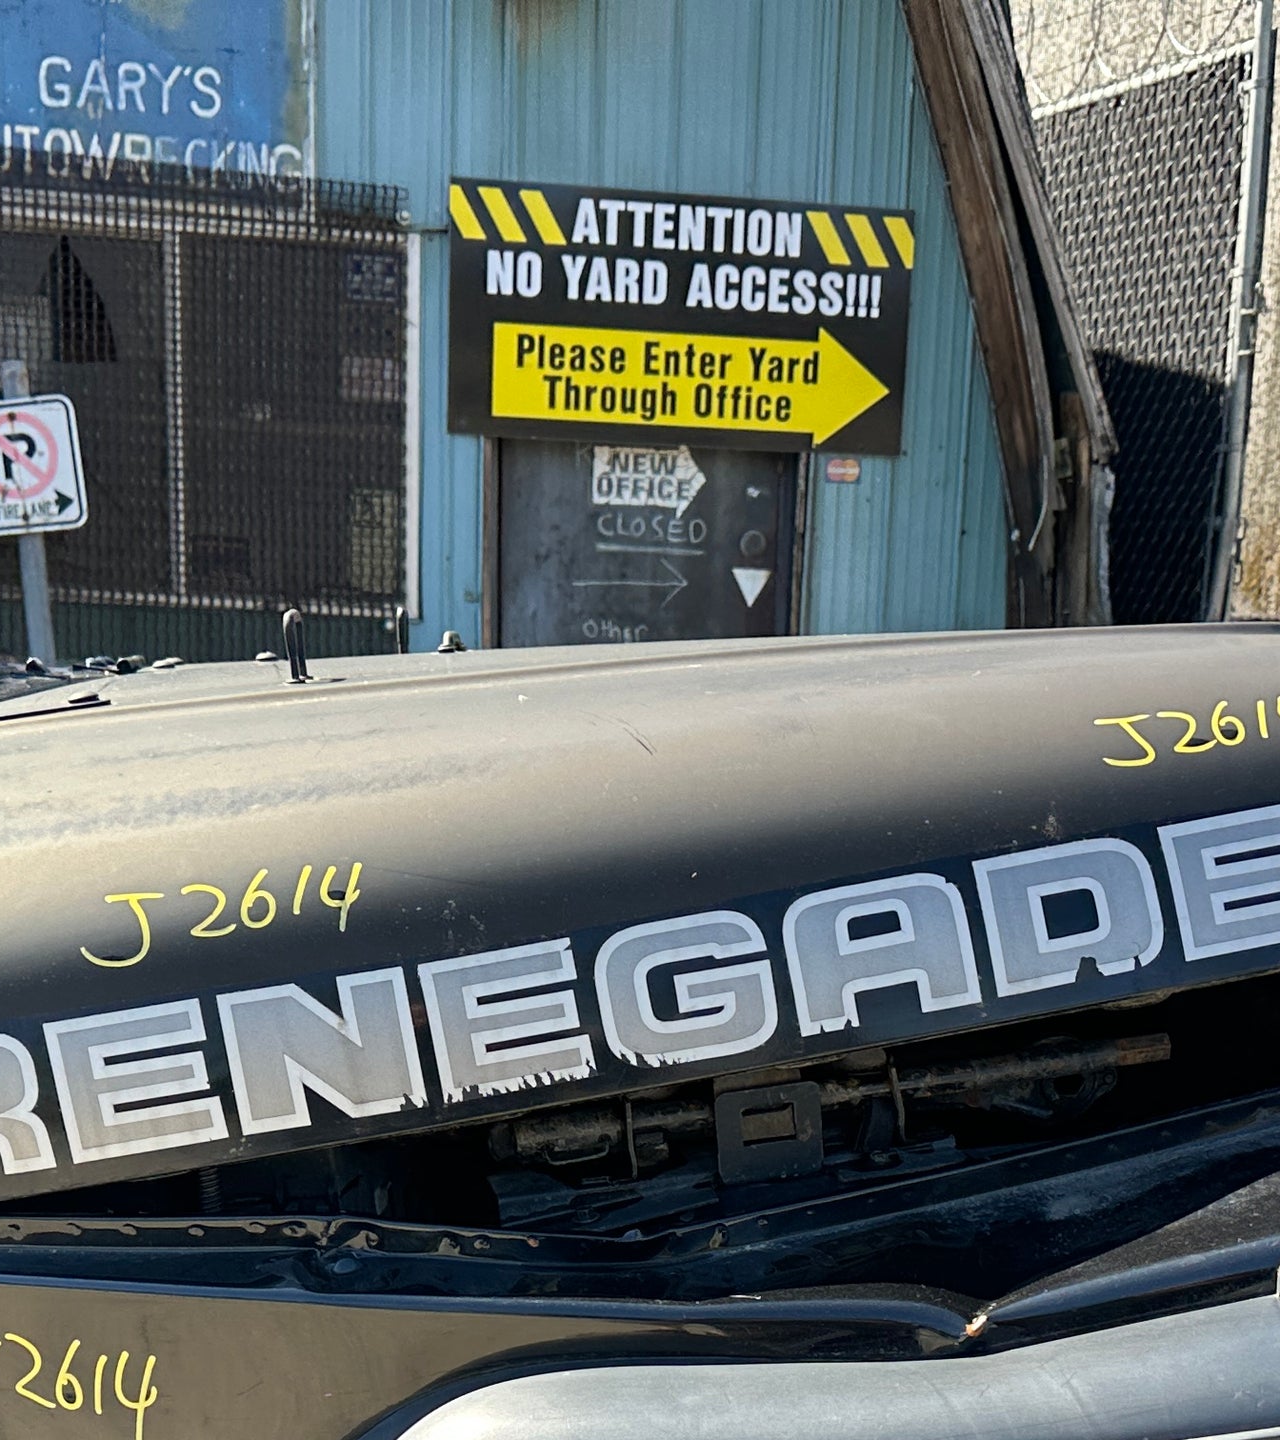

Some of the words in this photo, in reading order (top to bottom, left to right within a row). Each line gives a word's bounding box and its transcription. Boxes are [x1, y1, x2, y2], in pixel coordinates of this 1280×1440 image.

[38, 55, 223, 119] GARY'S
[572, 198, 802, 258] ATTENTION
[486, 249, 543, 297] NO
[561, 254, 668, 305] YARD
[686, 262, 882, 318] ACCESS!!!
[515, 333, 626, 374] Please
[644, 341, 733, 380] Enter
[749, 347, 820, 386] Yard
[543, 376, 677, 421] Through
[693, 384, 791, 423] Office
[597, 474, 693, 500] OFFICE
[610, 451, 677, 475] NEW
[597, 513, 707, 544] CLOSED
[80, 861, 363, 968] J2614
